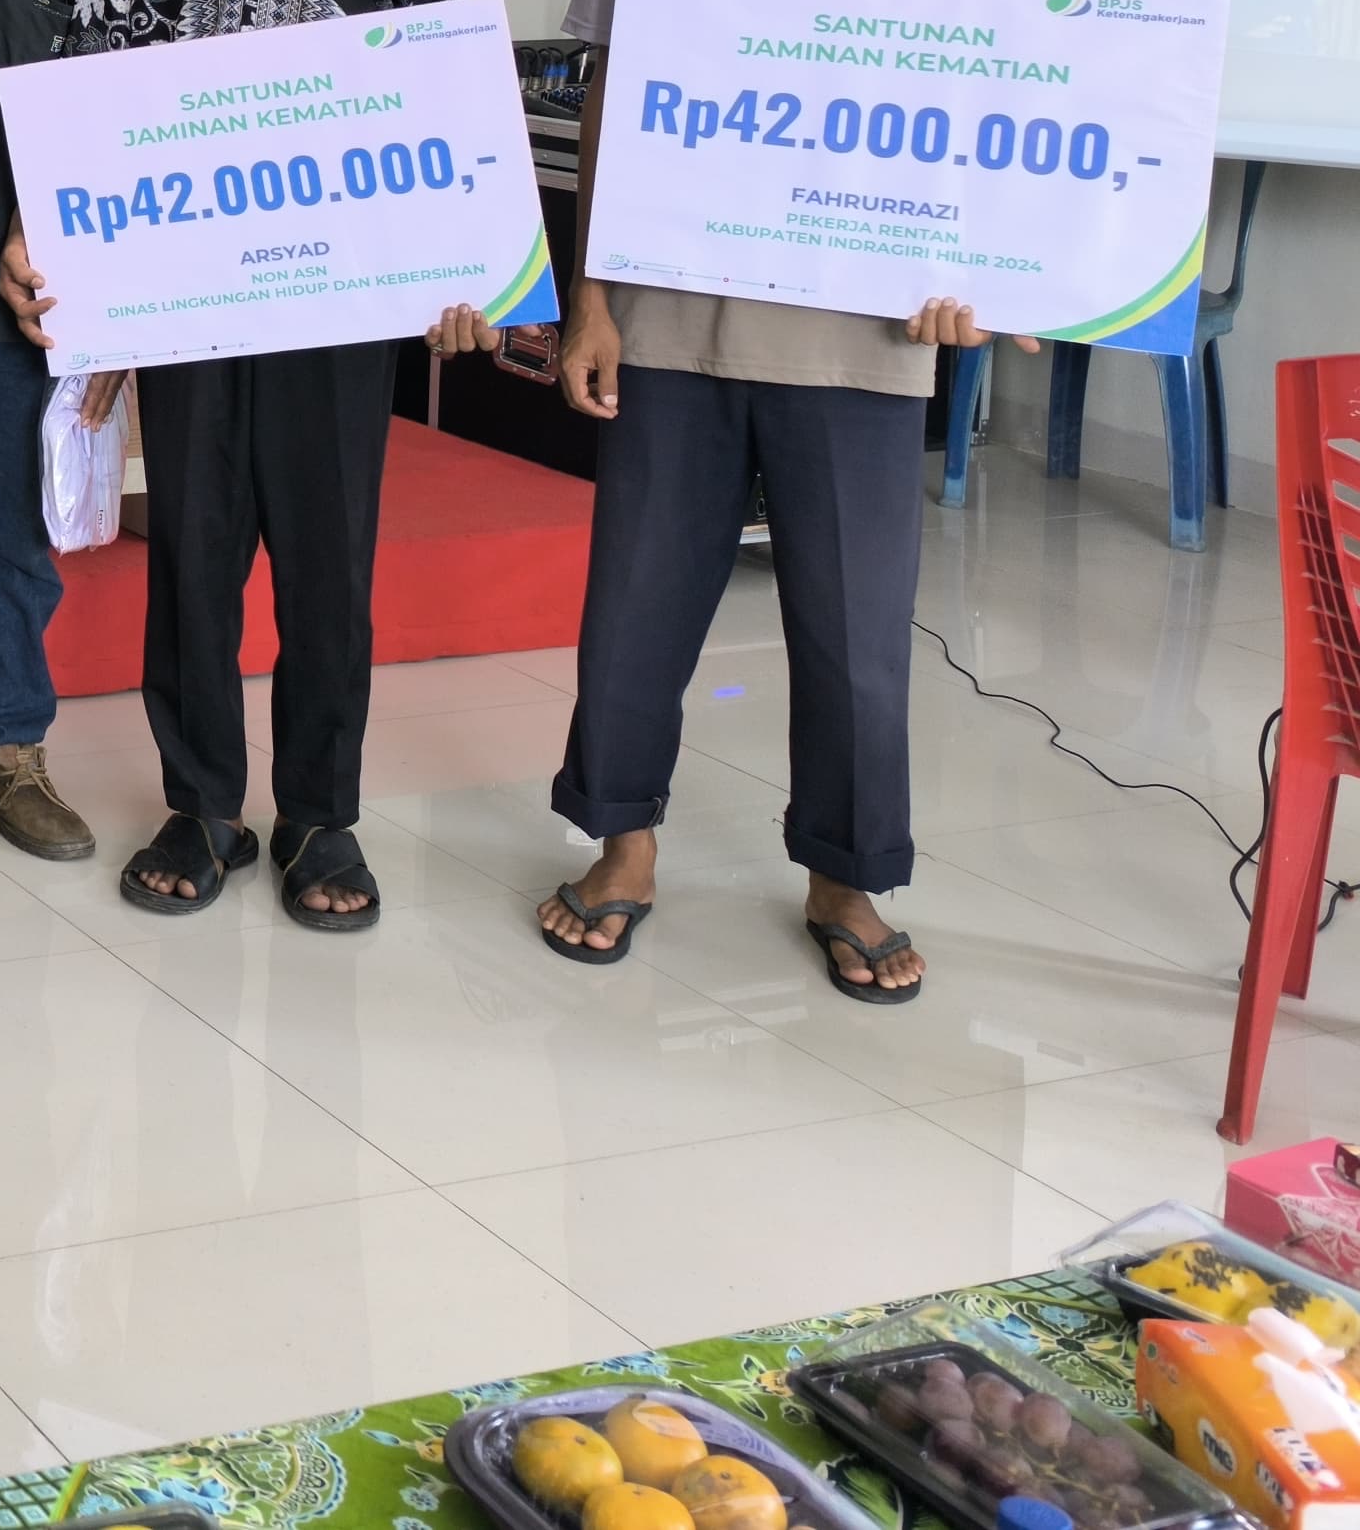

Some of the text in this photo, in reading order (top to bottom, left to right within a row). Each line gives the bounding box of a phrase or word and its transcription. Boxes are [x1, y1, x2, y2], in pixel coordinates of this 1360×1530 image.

[405, 20, 444, 35] BPJS
[407, 24, 497, 43] Ketenagakerjaan
[814, 13, 996, 48] SANTUNAN
[1096, 8, 1206, 26] Ketenagakerjaan
[737, 36, 1071, 85] JAMINAN KEMATIAN
[179, 73, 334, 112] SANTUNAN
[123, 91, 403, 148] JAMINAN KEMATIAN
[640, 80, 1162, 192] Rp42.000.000,-
[55, 136, 497, 244] Rp42.000.000,-
[791, 186, 960, 222] FAHRURRAZI
[786, 212, 960, 245] PEKERJA RENTAN
[240, 240, 331, 266] ARSYAD
[705, 220, 1044, 275] KABUPATEN INDRAGIRI HILIR 2024
[107, 263, 487, 319] DINAS LINGKUNGAN HIDUP DAN KEBERSIHAN
[251, 265, 328, 286] NON ASN
